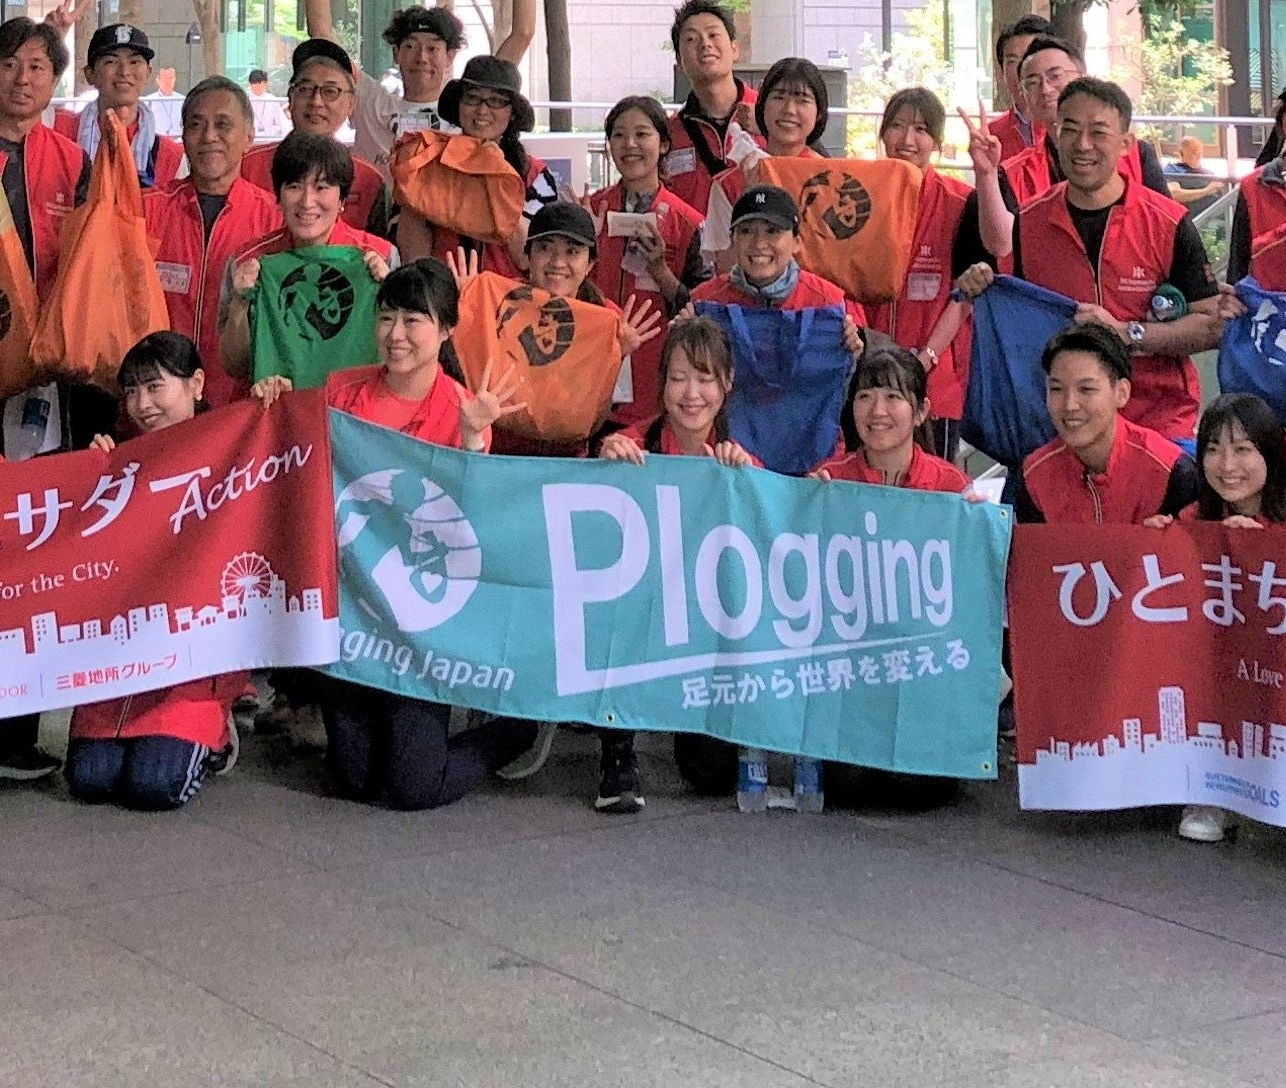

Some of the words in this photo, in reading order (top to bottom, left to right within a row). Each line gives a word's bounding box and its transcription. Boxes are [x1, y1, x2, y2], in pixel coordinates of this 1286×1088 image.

[169, 443, 313, 534] Action
[30, 573, 65, 594] the
[72, 559, 120, 583] City.
[542, 483, 954, 696] Plogging
[56, 653, 178, 690] 三菱地所グループ
[339, 626, 413, 676] ging
[416, 649, 515, 692] Japan
[681, 639, 971, 710] 足元から世界を変える
[1236, 658, 1250, 681] A
[1253, 660, 1283, 689] Love
